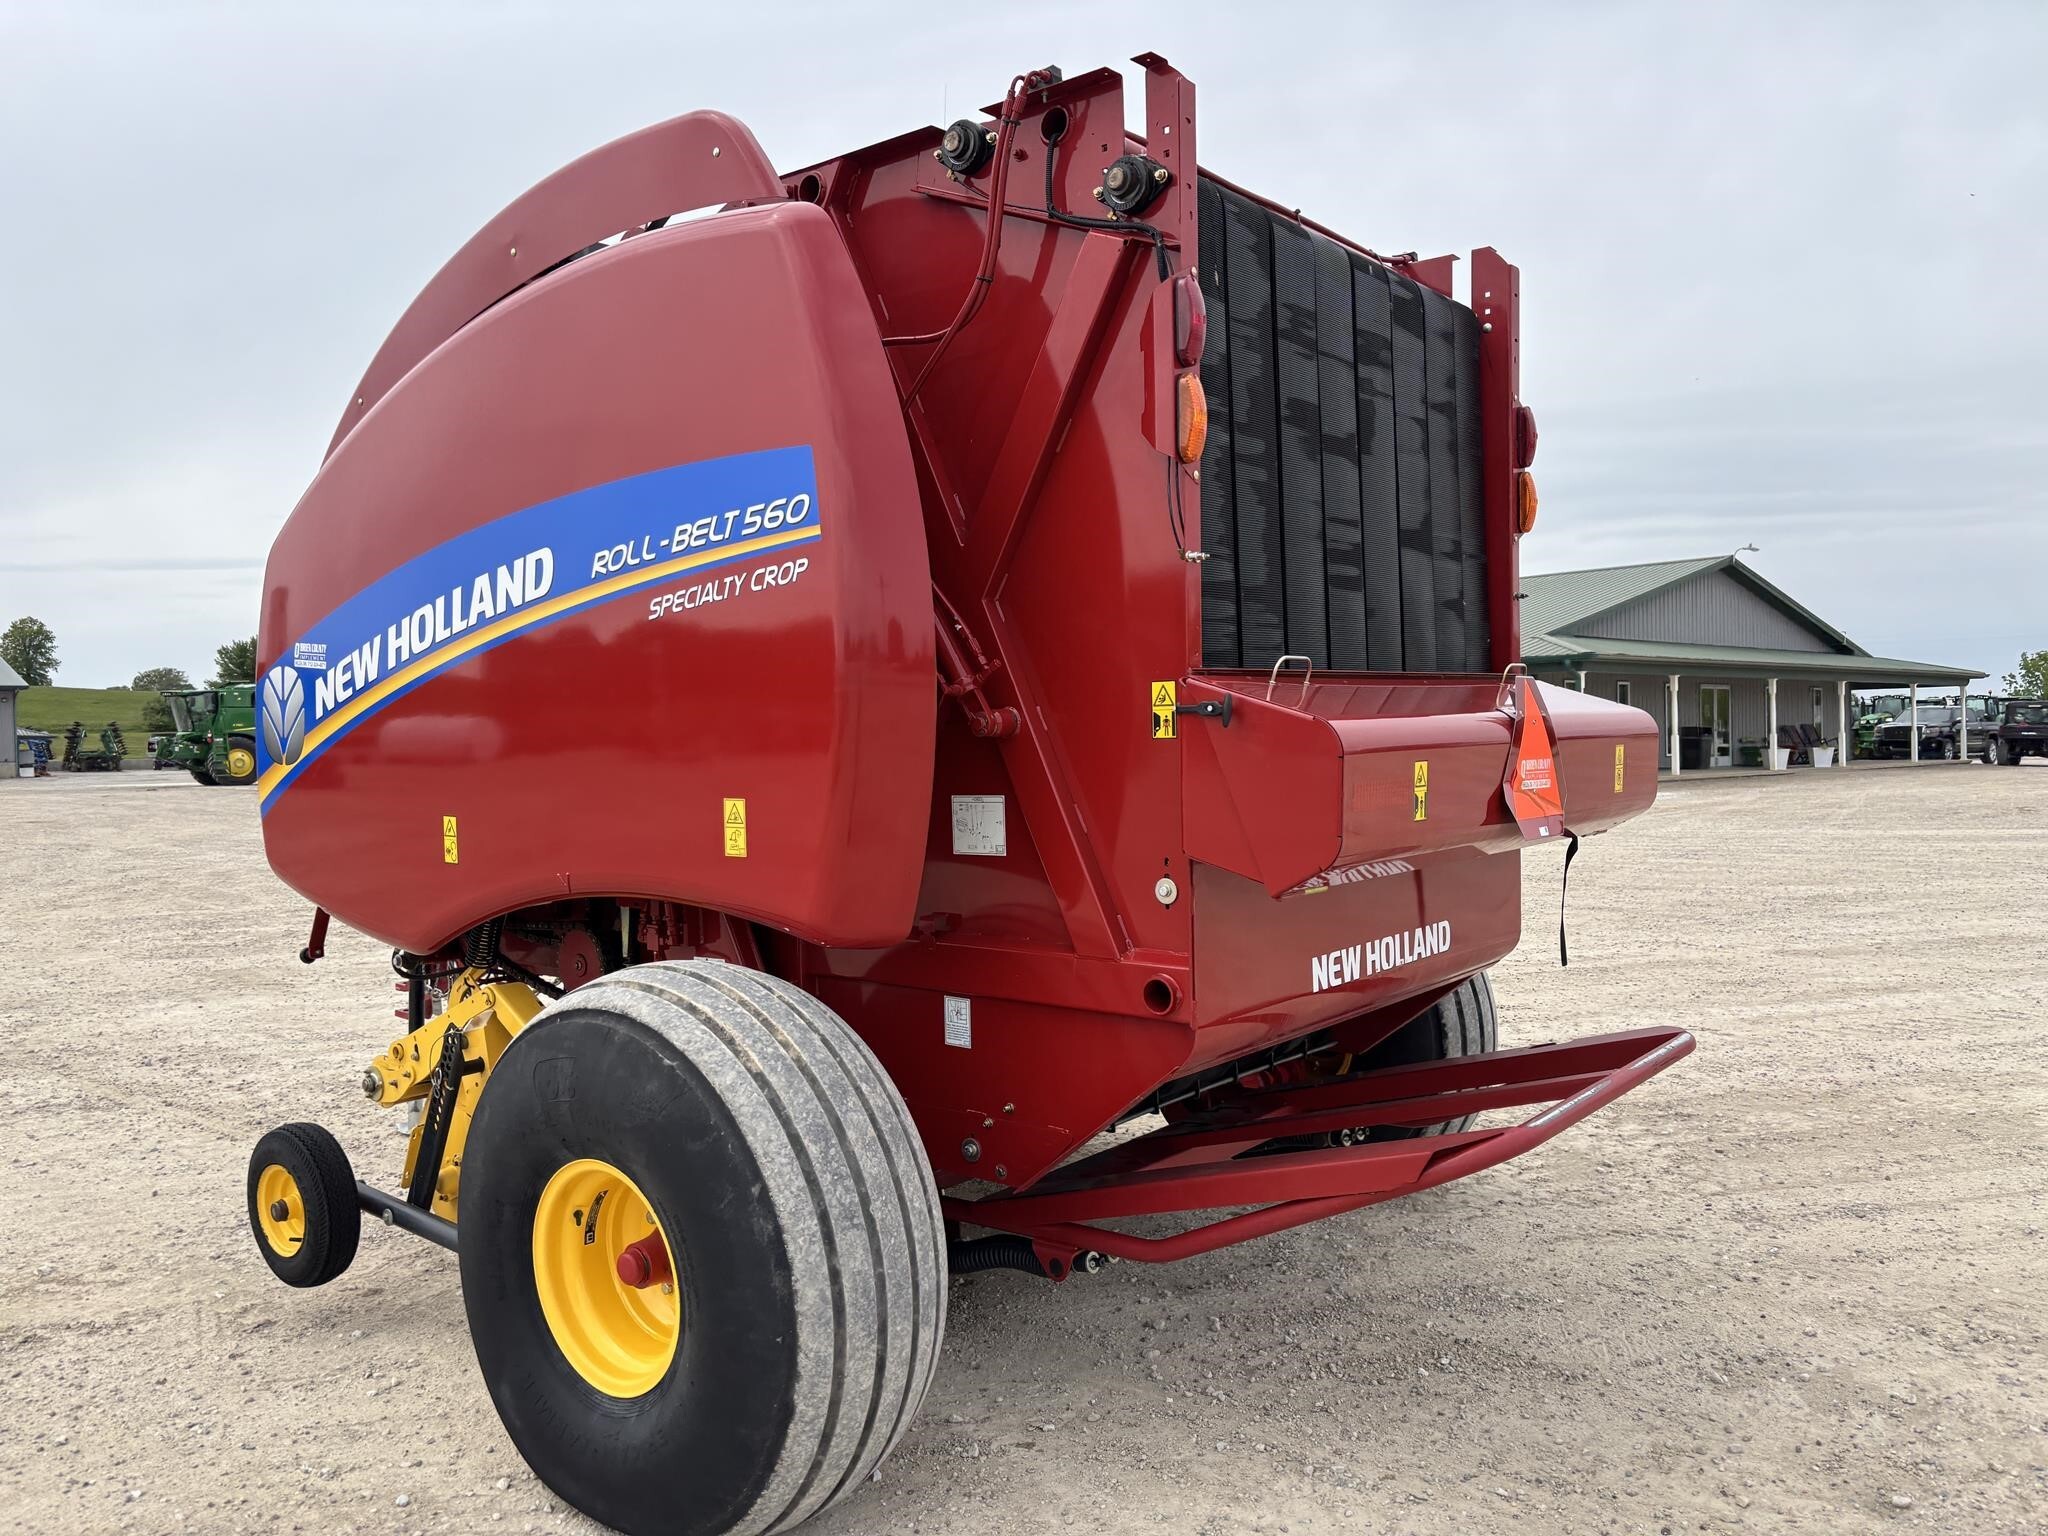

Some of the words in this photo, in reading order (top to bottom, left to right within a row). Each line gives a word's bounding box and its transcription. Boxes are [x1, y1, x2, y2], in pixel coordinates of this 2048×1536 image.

[741, 493, 811, 536] 560
[648, 572, 747, 621] SPECIALTY
[750, 557, 809, 592] CROP
[314, 634, 382, 720] NEW
[387, 547, 554, 671] HOLLAND
[1311, 944, 1362, 993] NEW
[1365, 920, 1451, 976] HOLLAND
